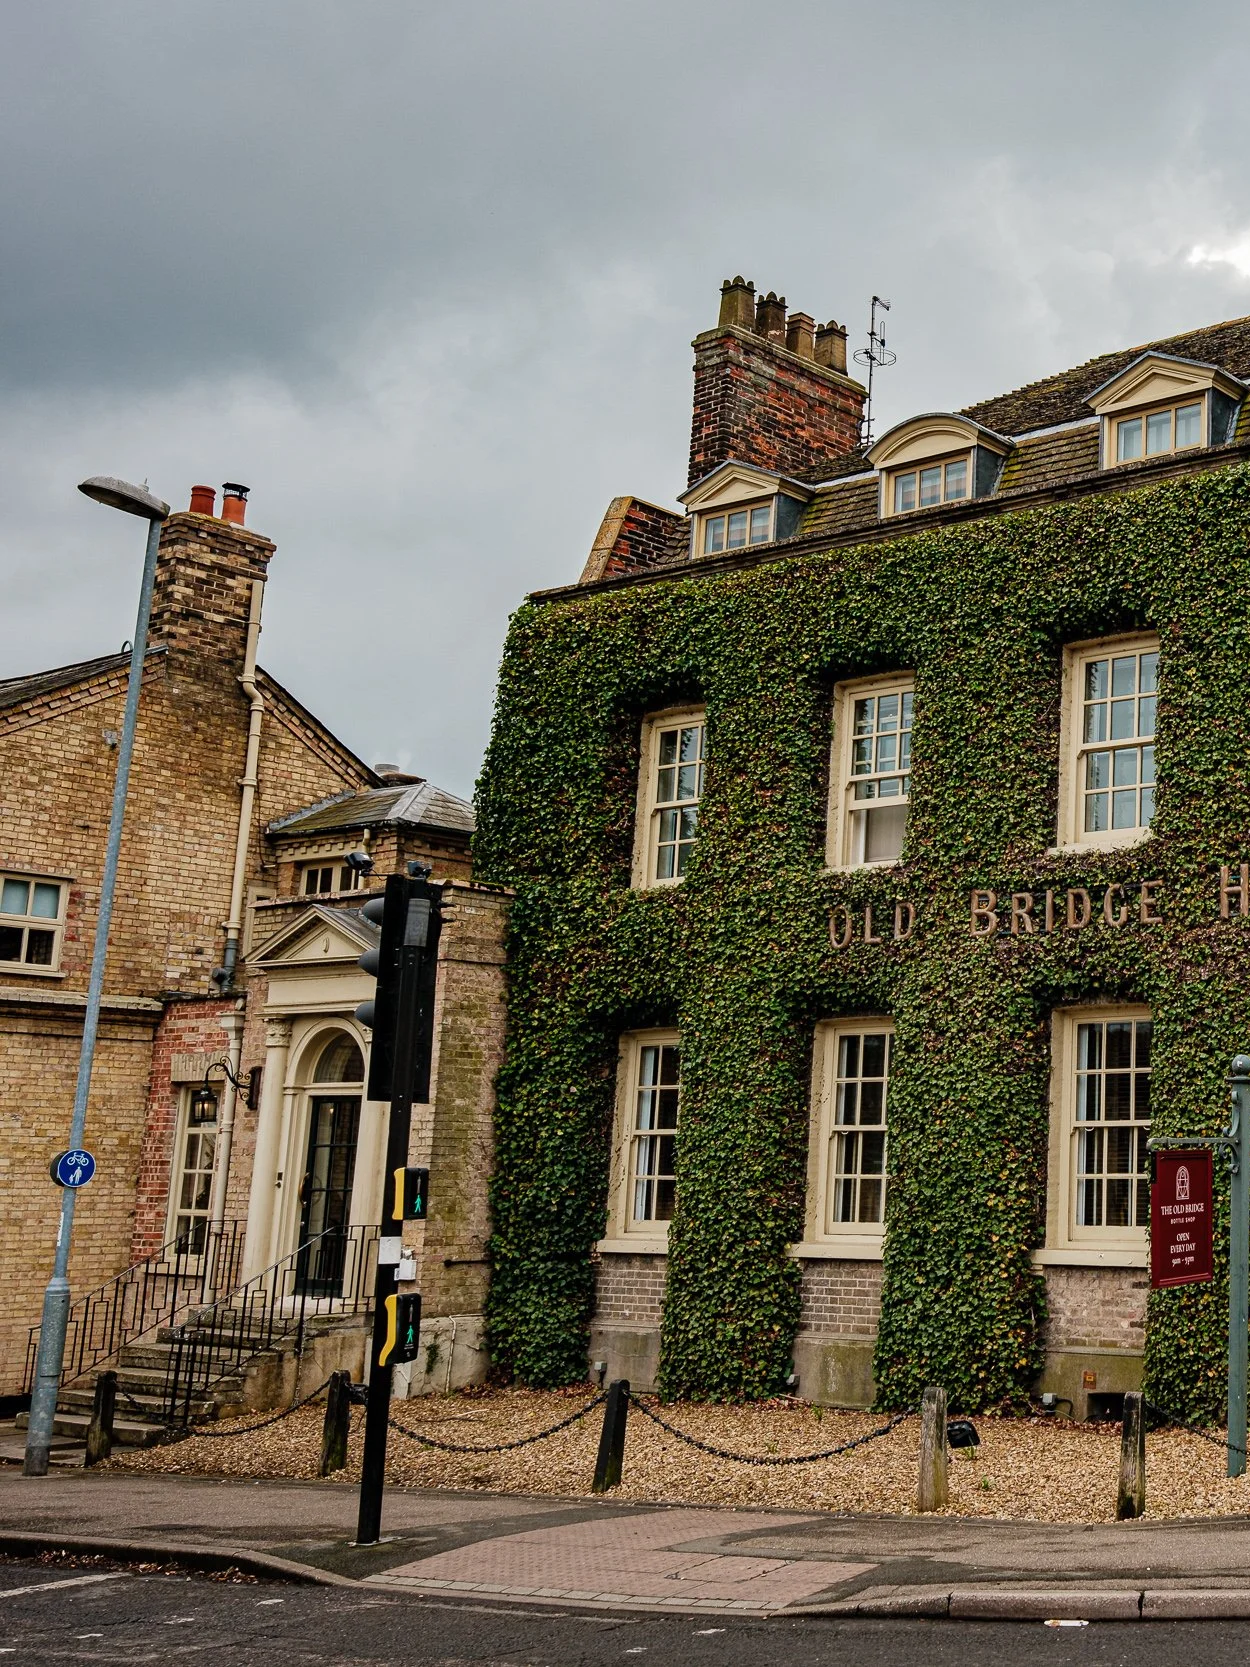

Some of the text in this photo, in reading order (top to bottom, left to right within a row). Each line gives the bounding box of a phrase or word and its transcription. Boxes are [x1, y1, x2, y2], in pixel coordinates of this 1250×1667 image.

[829, 903, 916, 949] OLD
[971, 879, 1163, 937] BRIDGE
[1161, 1202, 1204, 1216] THE OLD BRIDGE
[1176, 1232, 1190, 1242] OPEN
[1170, 1242, 1196, 1254] EVERY DAY
